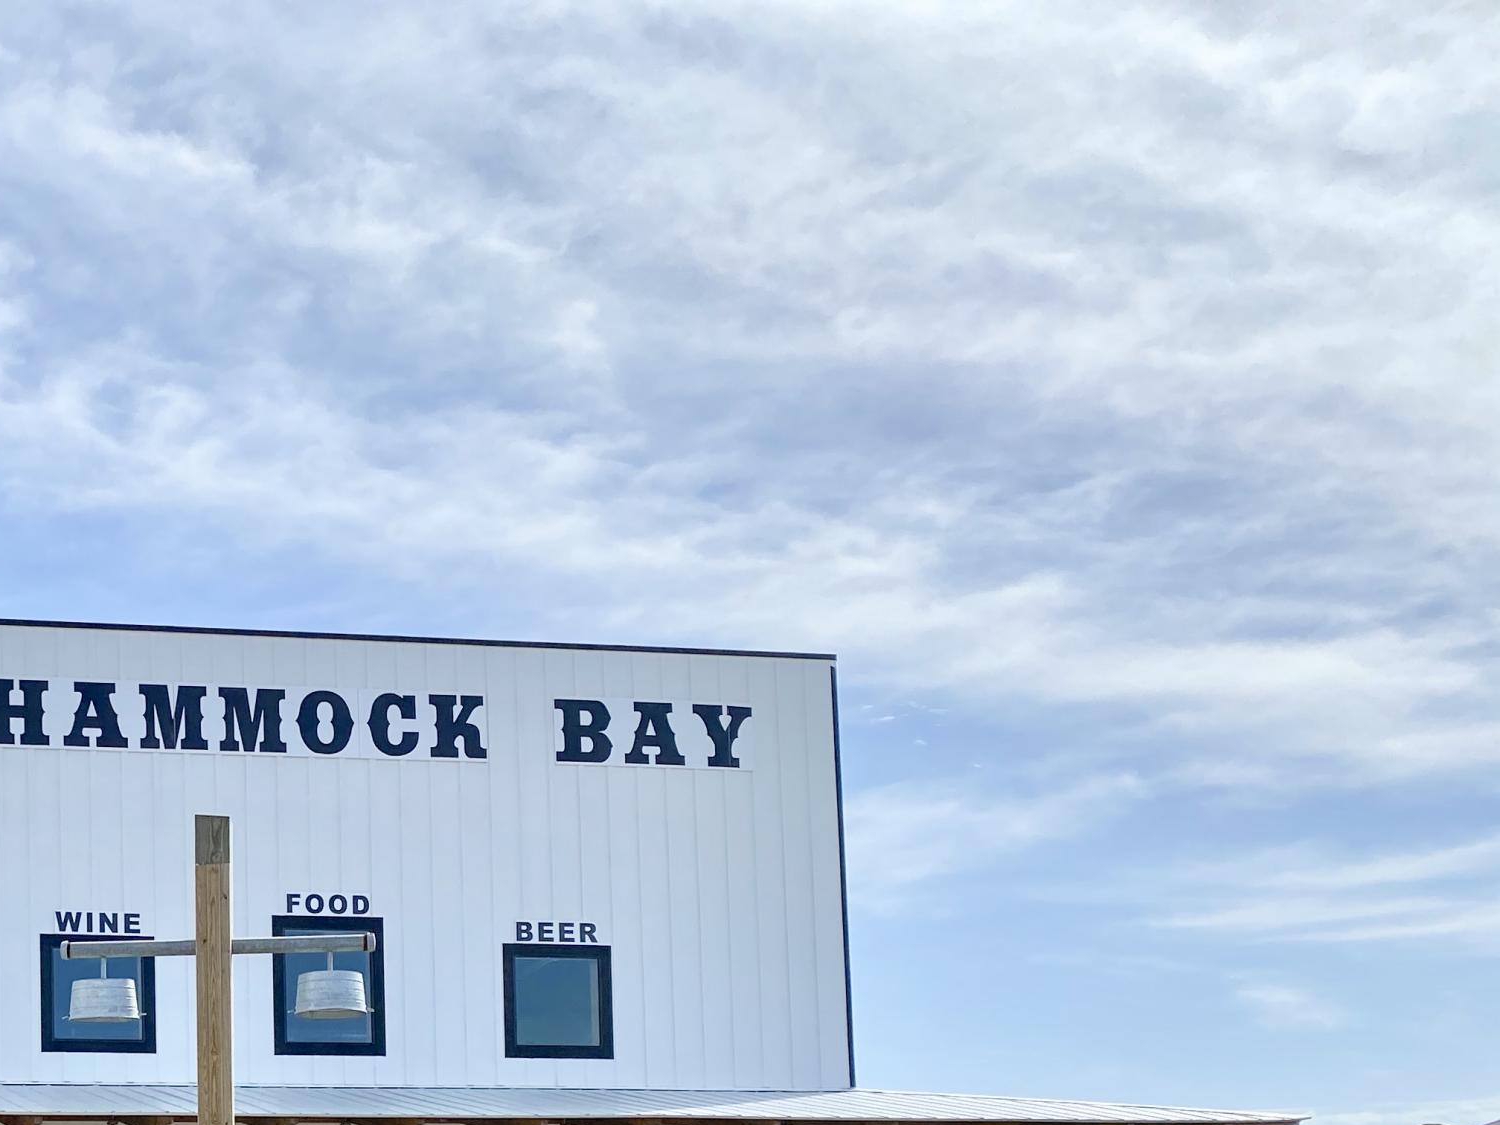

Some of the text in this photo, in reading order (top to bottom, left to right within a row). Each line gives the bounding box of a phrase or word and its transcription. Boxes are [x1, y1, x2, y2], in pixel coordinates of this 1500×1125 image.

[554, 698, 753, 768] BAY
[284, 893, 370, 916] FOOD
[55, 911, 142, 934] WINE
[515, 921, 598, 943] BEER
